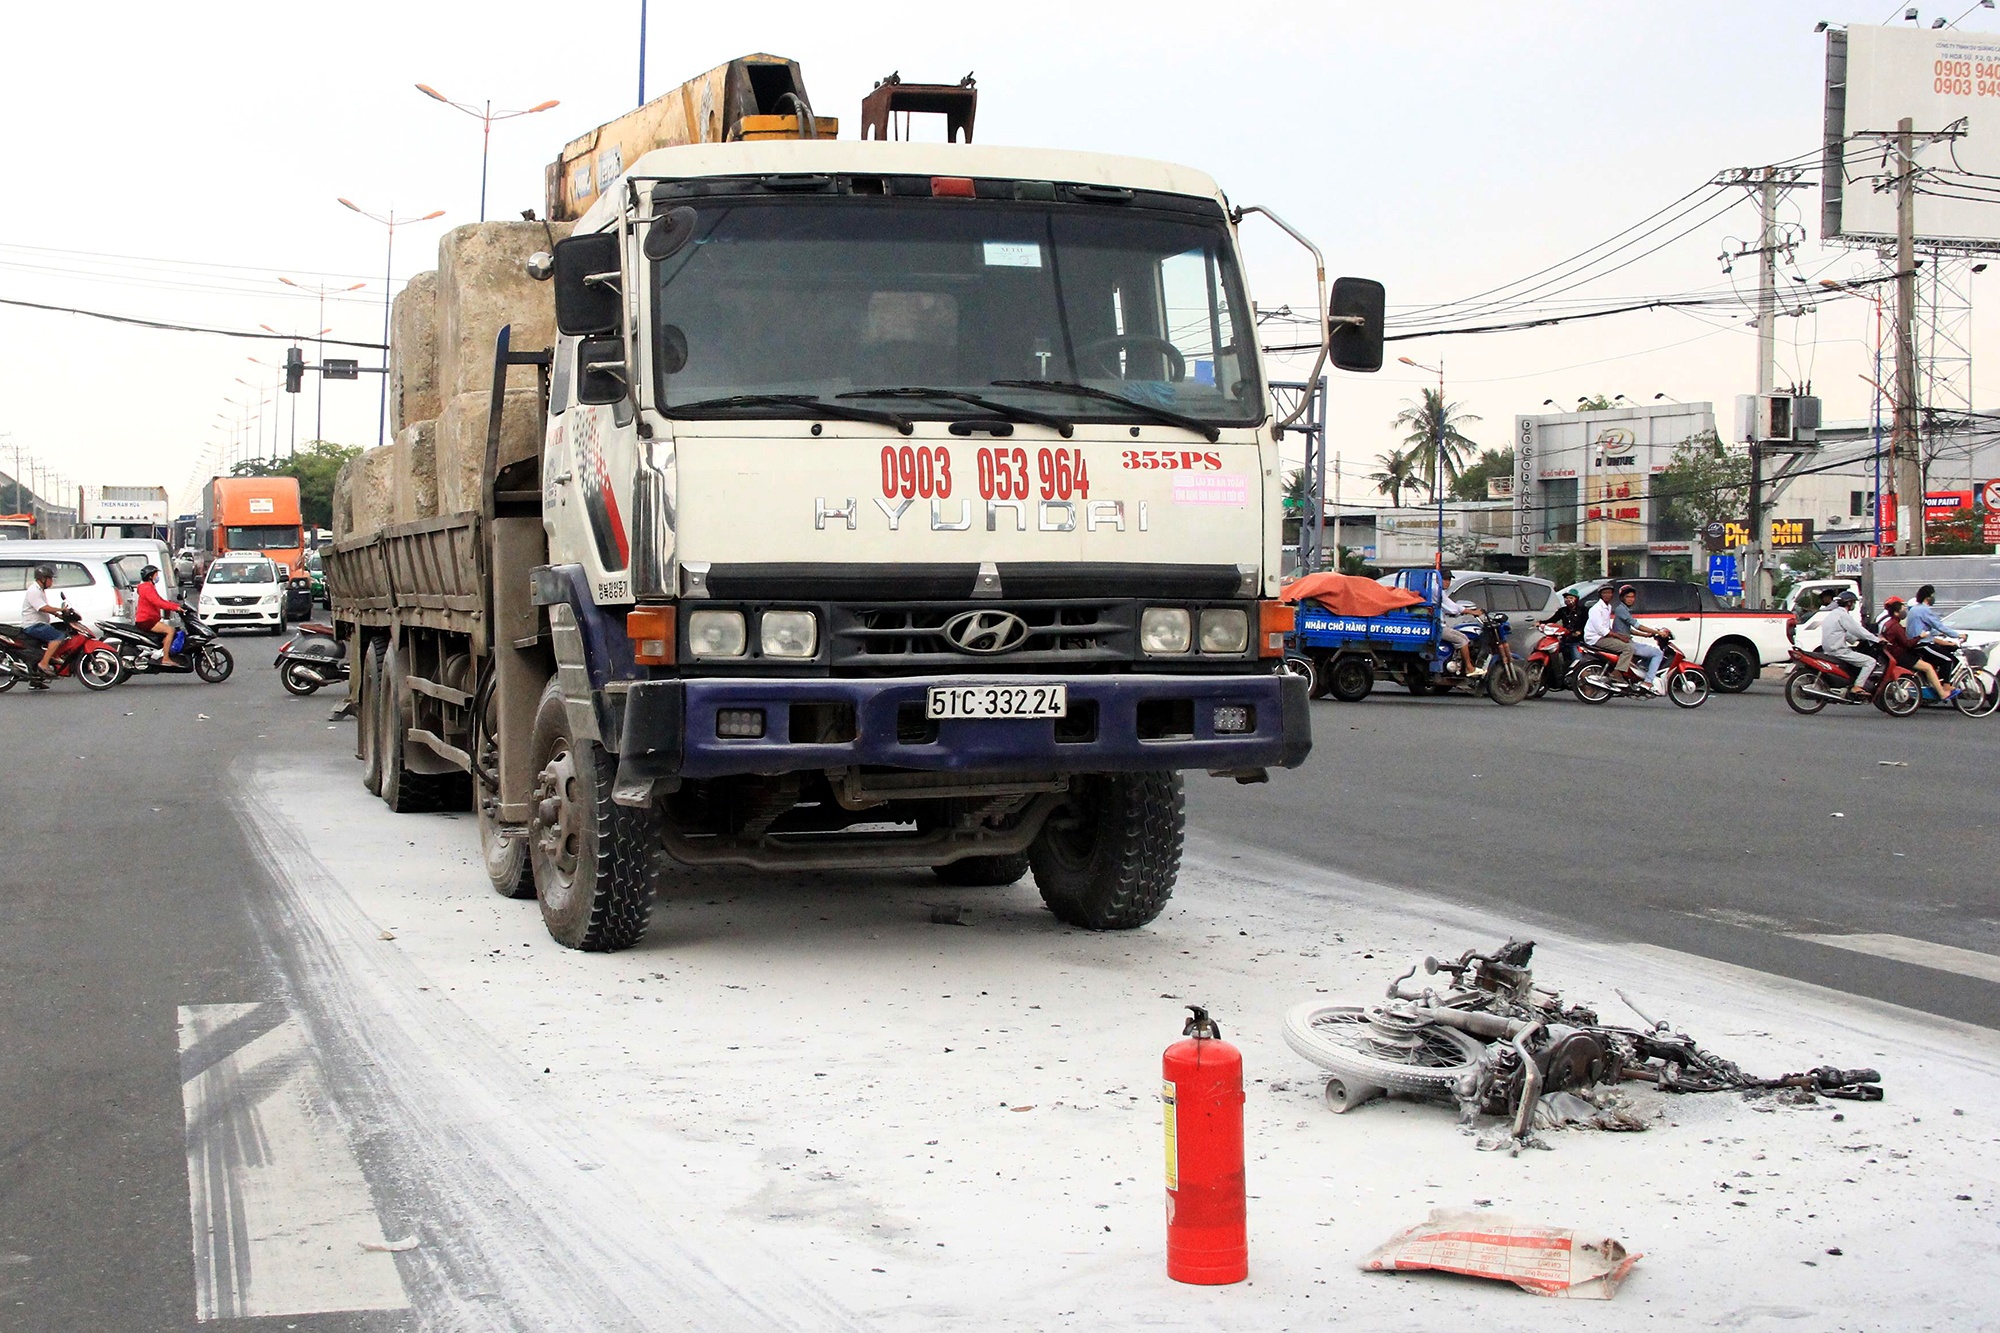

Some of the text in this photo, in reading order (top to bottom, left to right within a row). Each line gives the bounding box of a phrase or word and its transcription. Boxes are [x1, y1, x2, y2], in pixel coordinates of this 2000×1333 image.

[1934, 60, 1971, 78] 0903
[1934, 77, 1972, 96] 0903
[1122, 450, 1222, 470] 355PS
[881, 446, 1090, 500] 0903 053 964
[1938, 498, 1959, 506] PAINT
[815, 497, 1147, 532] HYUNDAI
[1305, 621, 1326, 632] NHẬN
[1328, 621, 1344, 631] CHỞ
[1345, 621, 1367, 632] HÀNG
